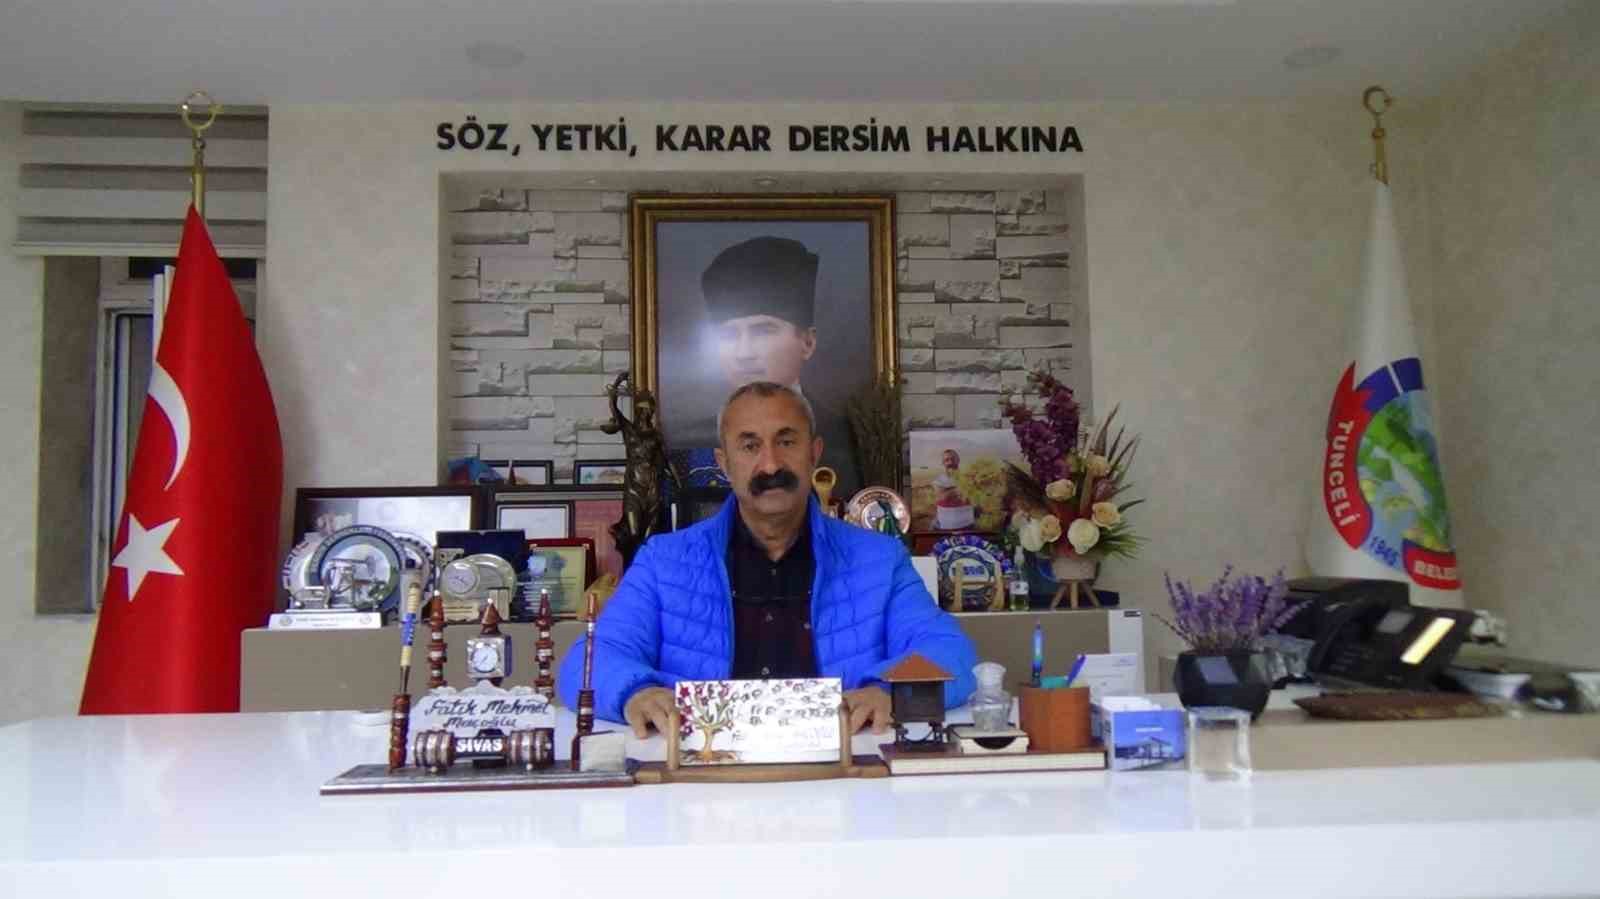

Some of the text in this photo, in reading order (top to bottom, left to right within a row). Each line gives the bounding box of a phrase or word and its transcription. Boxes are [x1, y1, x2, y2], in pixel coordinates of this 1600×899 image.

[436, 116, 1084, 157] SÖZ, YETKİ, KARAR DERSİM HALKINA
[1329, 420, 1361, 527] TUNCELİ
[456, 738, 504, 753] SIVAS
